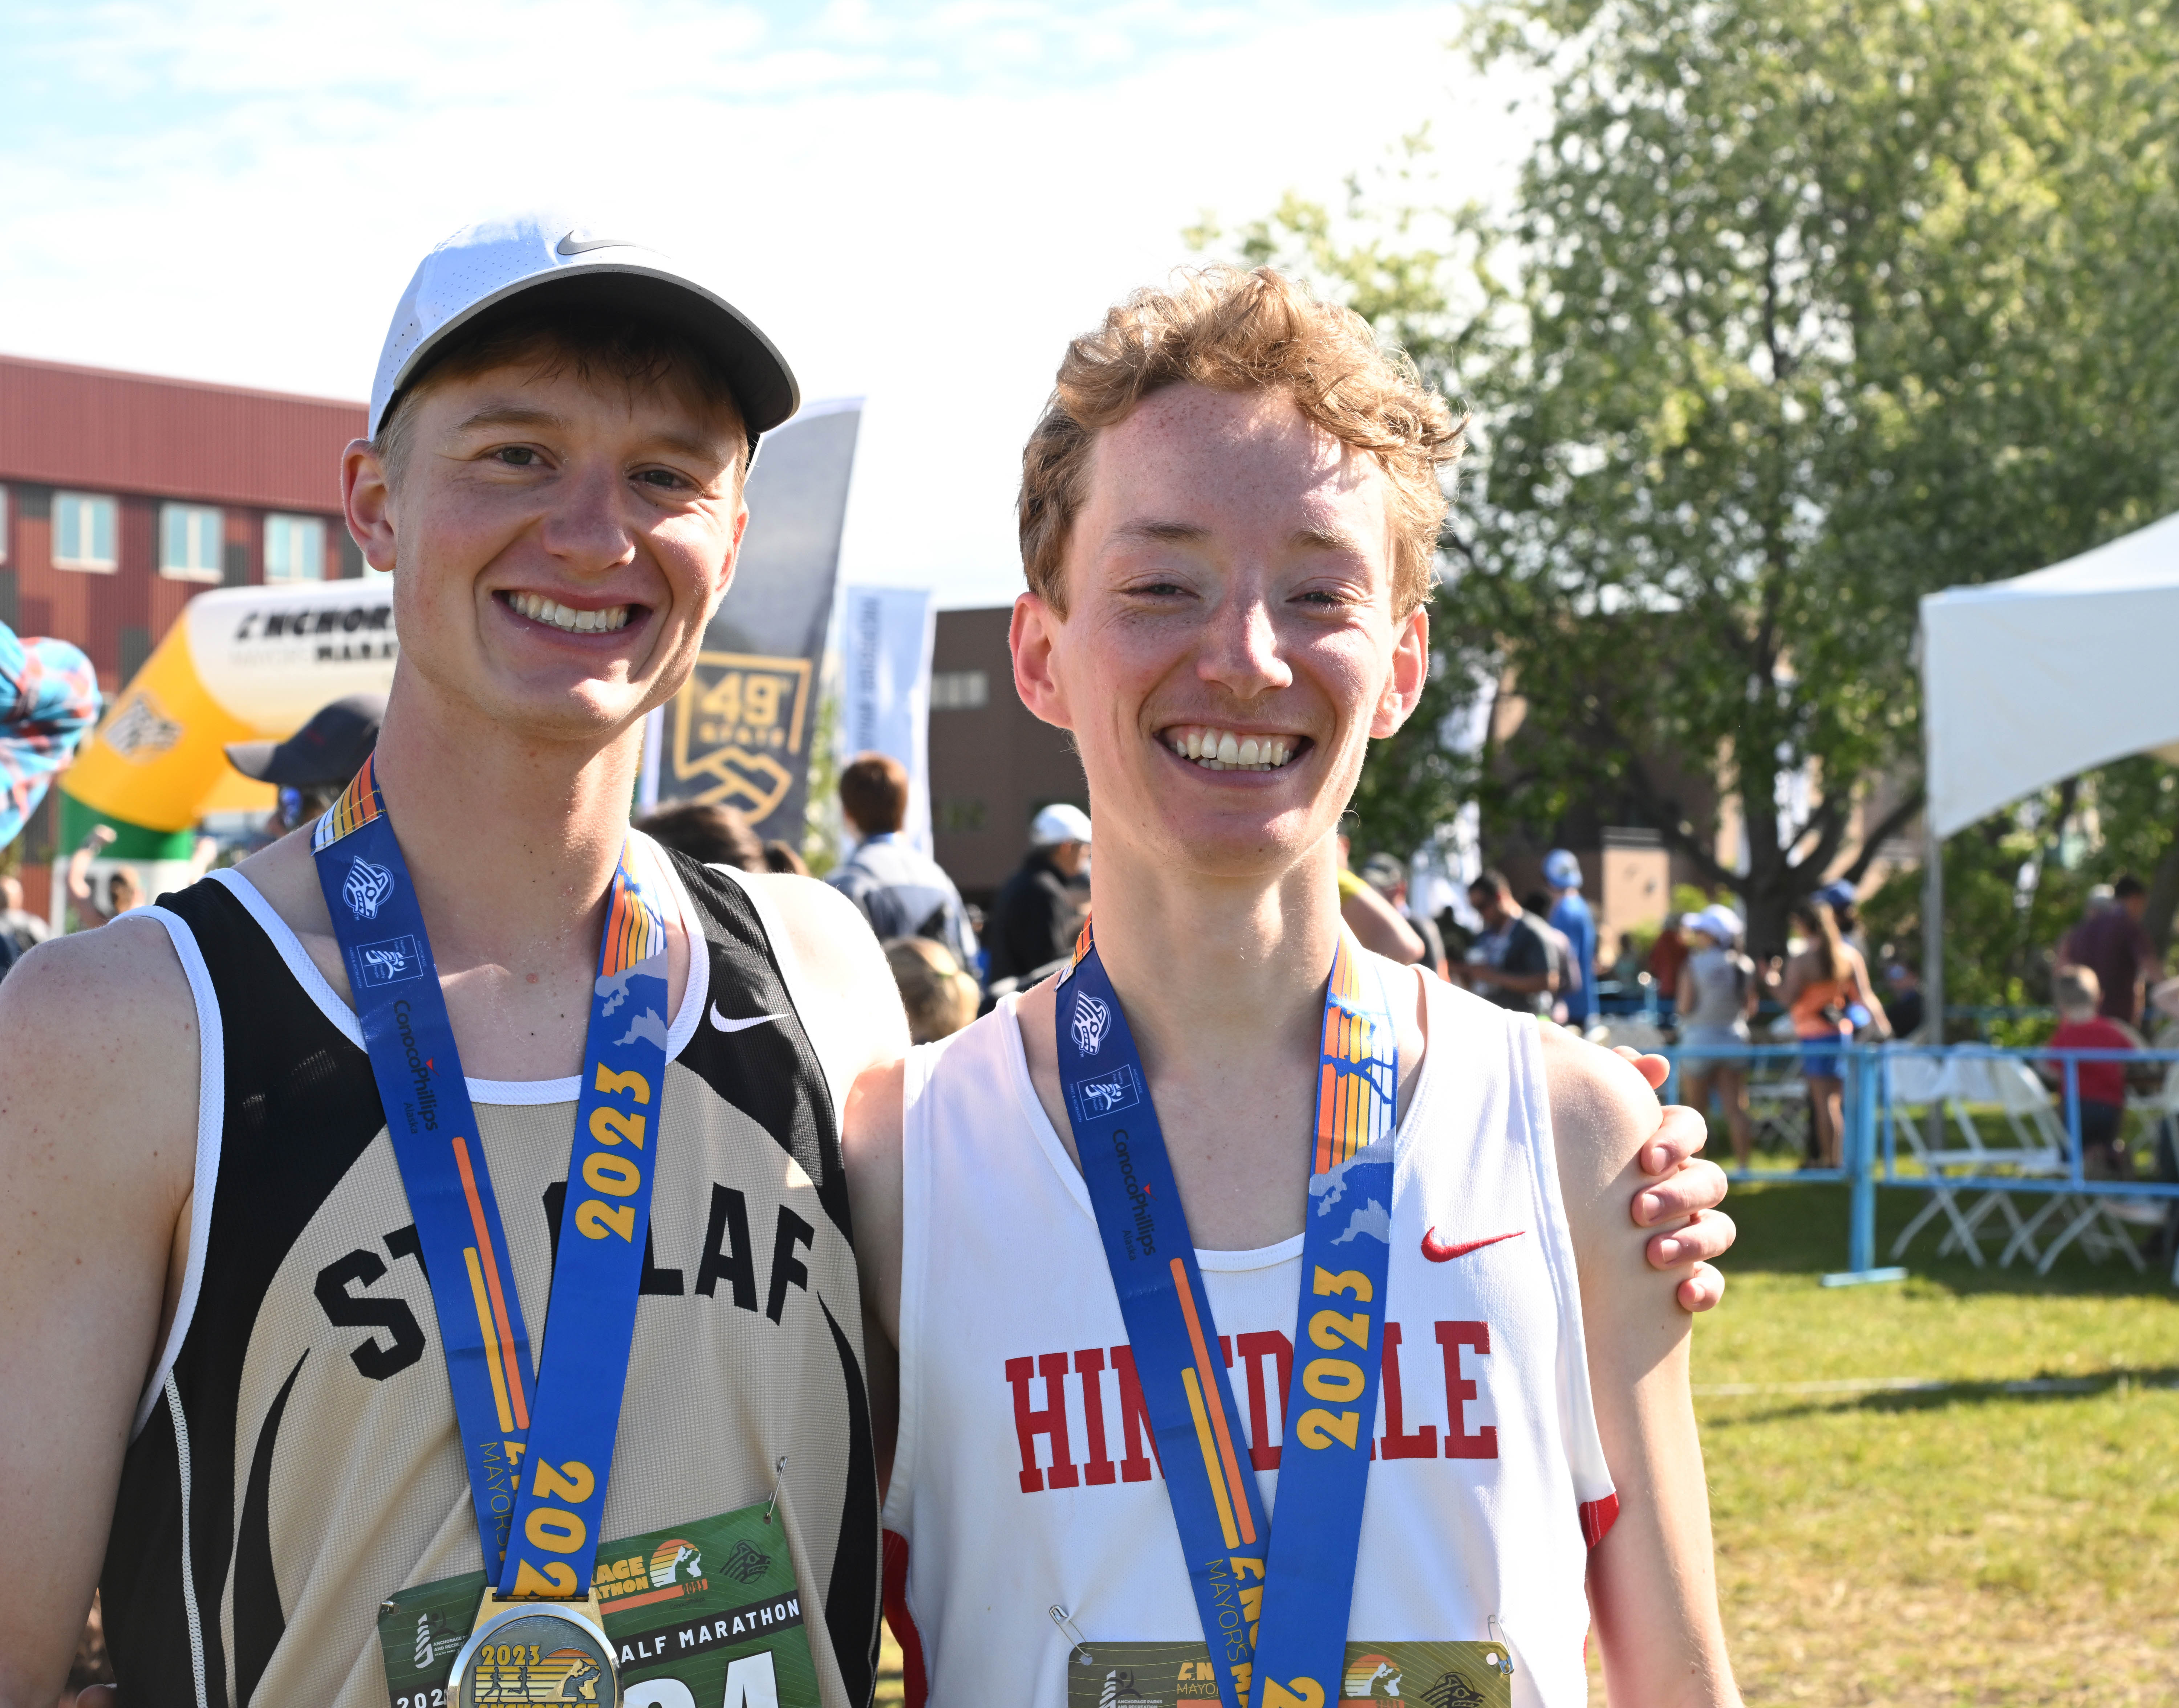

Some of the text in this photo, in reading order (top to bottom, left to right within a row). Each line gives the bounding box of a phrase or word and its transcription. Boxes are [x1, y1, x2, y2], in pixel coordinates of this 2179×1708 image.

[417, 940, 427, 967] ANCHORAGE
[394, 1000, 438, 1131] ConocoPhillips
[403, 1101, 419, 1134] Alaska
[575, 1061, 650, 1244] 2023
[1112, 1128, 1156, 1256] ConocoPhillips
[1121, 1229, 1137, 1261] Alaska
[1297, 1264, 1373, 1451] 2023
[679, 1599, 799, 1648] MARATHON
[1205, 1559, 1250, 1662] MAYOR'S
[433, 1636, 462, 1646] ANCHORAGE
[481, 1644, 540, 1665] 2023
